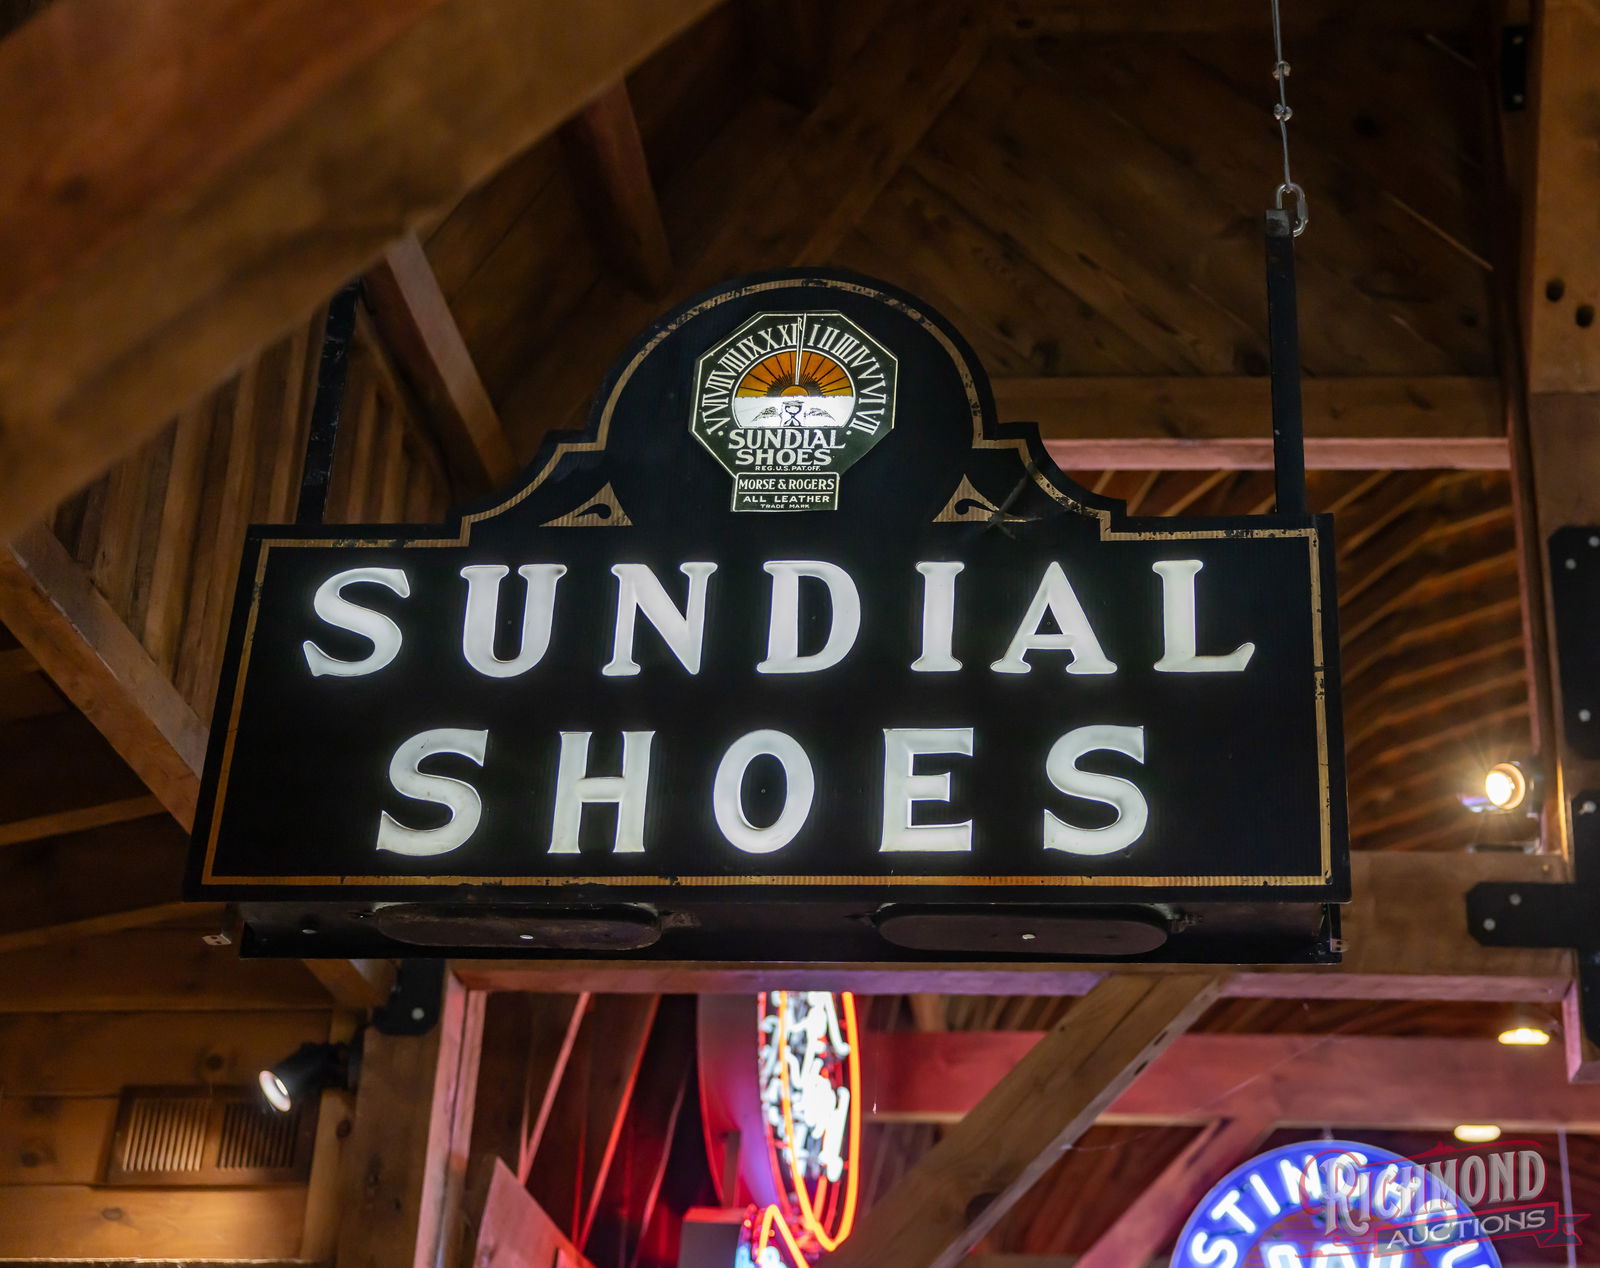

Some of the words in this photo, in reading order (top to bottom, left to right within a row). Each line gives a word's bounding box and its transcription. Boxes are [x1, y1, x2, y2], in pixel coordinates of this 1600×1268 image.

[728, 429, 846, 449] SUNDIAL
[735, 449, 832, 465] SHOES
[738, 479, 776, 490] MORSE
[777, 479, 787, 490] &
[788, 478, 835, 490] ROGERS
[743, 495, 767, 503] ALL
[774, 495, 830, 503] LEATHER
[303, 559, 1256, 678] SUNDIAL
[376, 725, 1149, 856] SHOES
